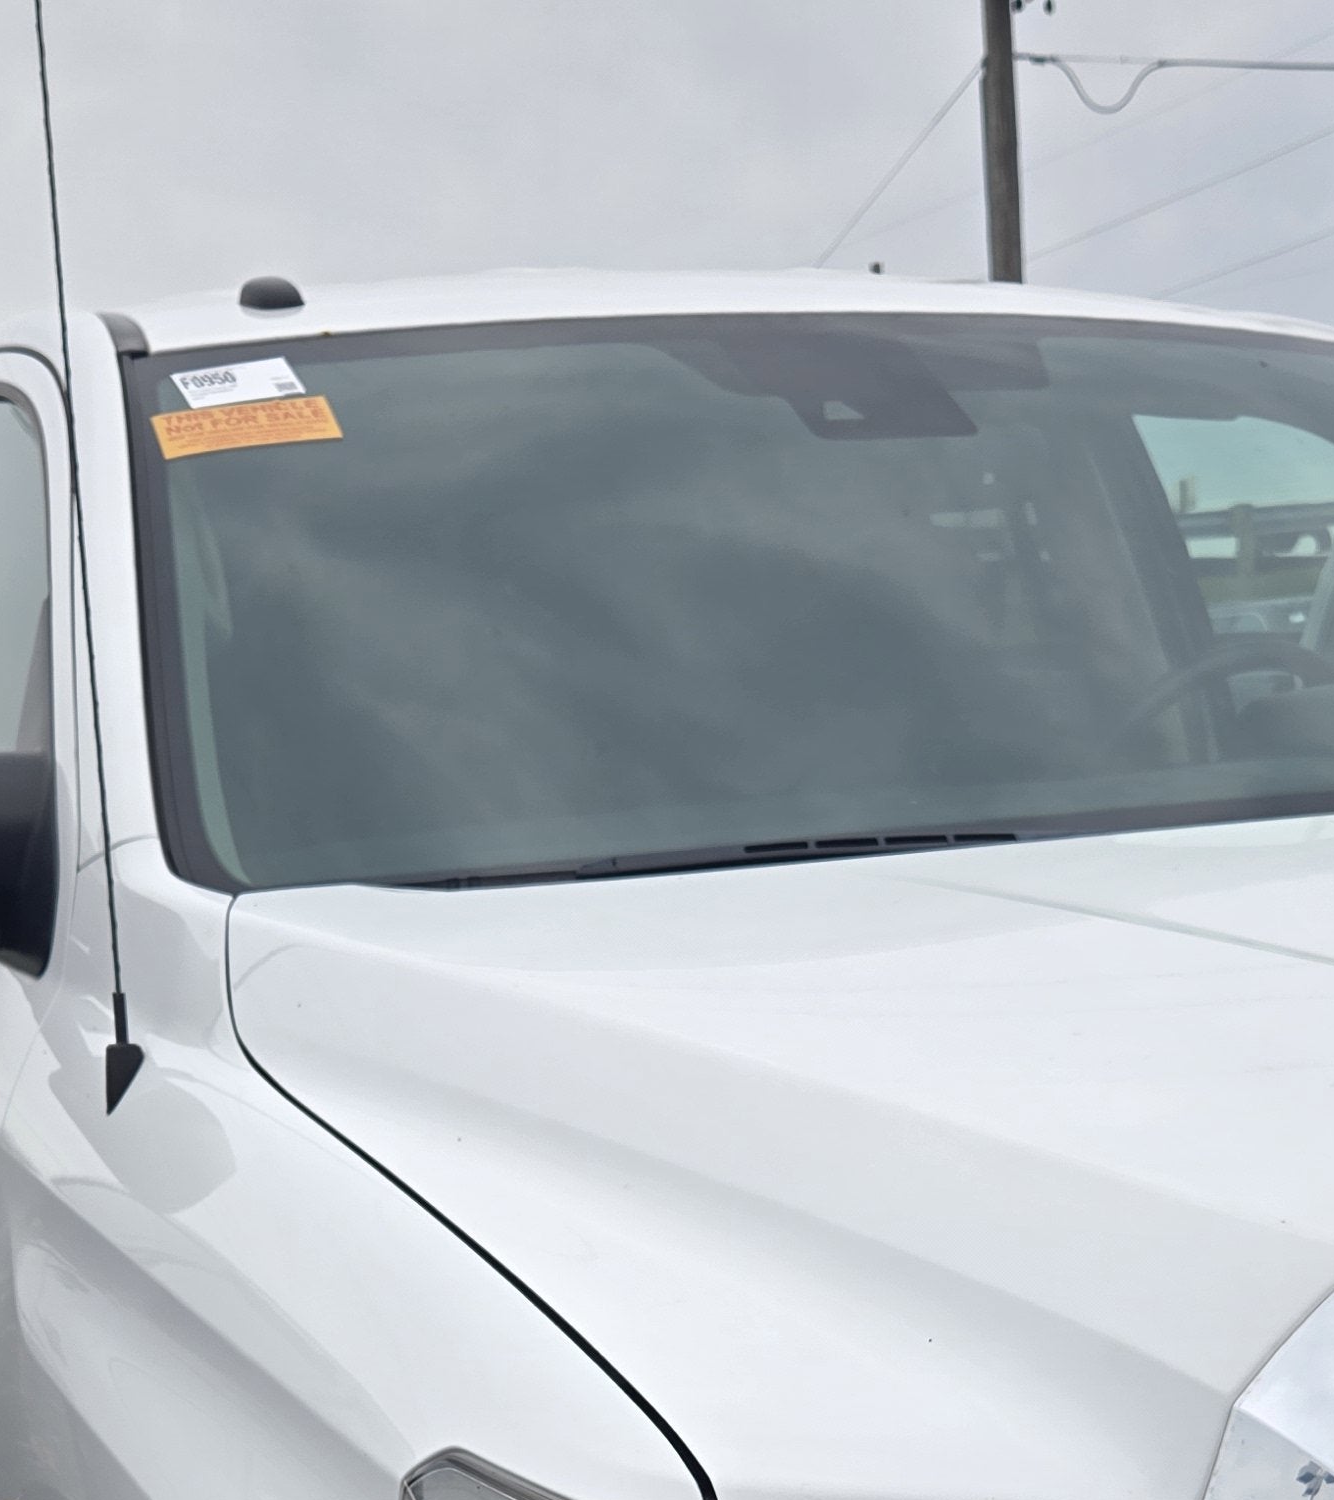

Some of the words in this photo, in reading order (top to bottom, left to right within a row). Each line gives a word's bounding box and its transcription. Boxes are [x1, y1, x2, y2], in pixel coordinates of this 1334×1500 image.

[179, 371, 237, 390] F0950
[163, 411, 214, 426] THIS
[219, 399, 318, 417] VEHICLE
[211, 414, 260, 429] FOR
[268, 406, 326, 421] SALE
